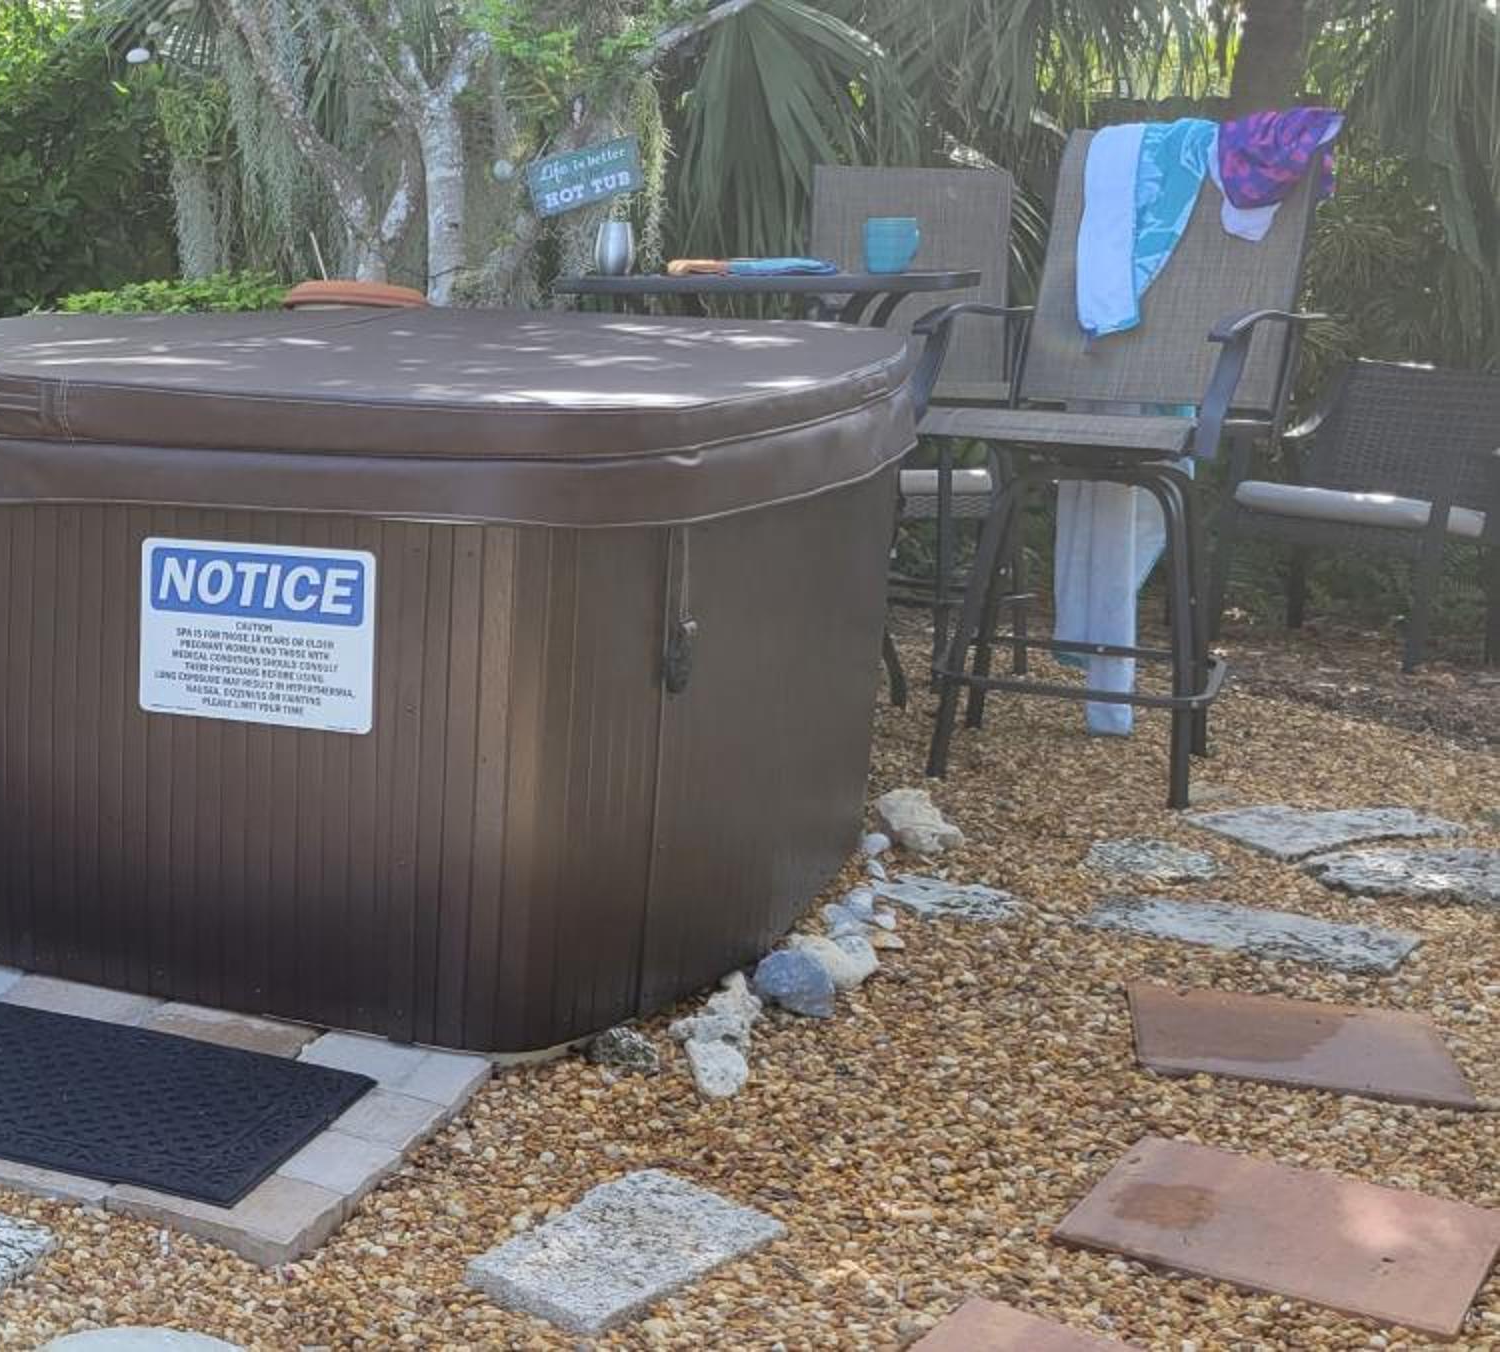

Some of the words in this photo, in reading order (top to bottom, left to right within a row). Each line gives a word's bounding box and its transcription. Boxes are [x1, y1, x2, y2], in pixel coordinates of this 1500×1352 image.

[587, 147, 626, 167] better
[545, 184, 584, 209] HOT
[591, 171, 631, 194] TUB
[159, 557, 359, 615] NOTICE
[235, 621, 273, 632] CAUTION
[176, 627, 192, 638] SPA
[193, 629, 202, 638] IS
[204, 629, 220, 640] FOR
[222, 631, 248, 642] THOSE
[263, 635, 290, 646] YEARS
[292, 637, 304, 647] OR
[305, 639, 335, 649] OLDER
[180, 639, 222, 651] PREGNANT
[225, 643, 257, 654] WOMEN
[260, 646, 276, 657] AND
[279, 647, 306, 659] THOSE
[308, 651, 330, 661] WITH
[172, 649, 206, 660] MEDICAL
[210, 653, 260, 665] CONDITIONS
[262, 657, 296, 669] SHOULD
[300, 661, 339, 673] CONSULT
[185, 661, 208, 672] THEIR
[210, 664, 259, 677] PHYSICIANS
[262, 669, 294, 680] BEFORE
[154, 669, 177, 681] LONG
[178, 671, 220, 685] EXPOSURE
[223, 677, 241, 687] MAY
[242, 679, 273, 690] RESULT
[276, 681, 285, 690] IN
[202, 697, 233, 708] PLEASE
[233, 699, 258, 711] LIMIT
[260, 703, 281, 713] YOUR
[282, 704, 304, 716] TIME
[223, 687, 266, 701] DIZZINESS
[267, 691, 280, 701] OR
[282, 692, 321, 706] FAINTING
